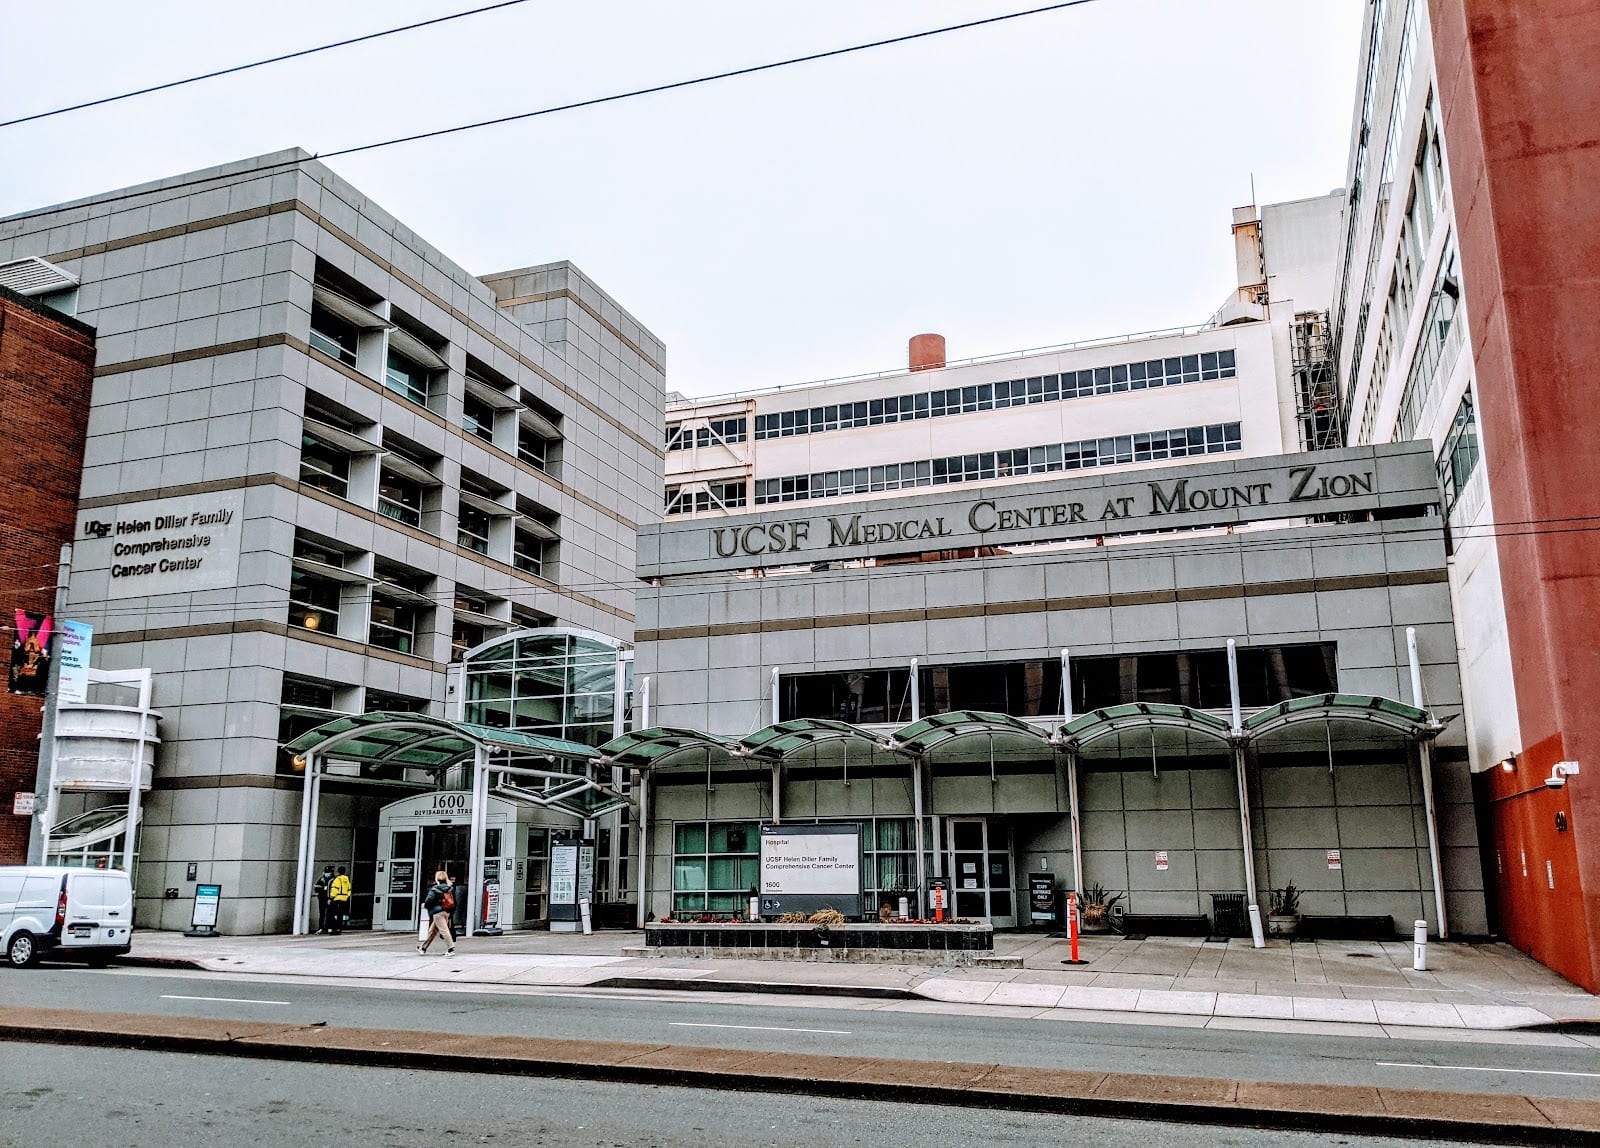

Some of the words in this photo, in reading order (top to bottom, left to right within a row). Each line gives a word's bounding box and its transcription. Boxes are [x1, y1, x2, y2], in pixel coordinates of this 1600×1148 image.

[116, 519, 151, 535] Helen
[154, 514, 188, 530] Diller
[191, 508, 234, 526] Family
[114, 534, 211, 556] Comprehensive
[713, 522, 810, 557] UCSF
[111, 562, 157, 578] Cancer
[159, 557, 203, 573] Center
[432, 794, 465, 809] 1600
[765, 863, 810, 871] Comprehensive
[818, 855, 838, 864] Family
